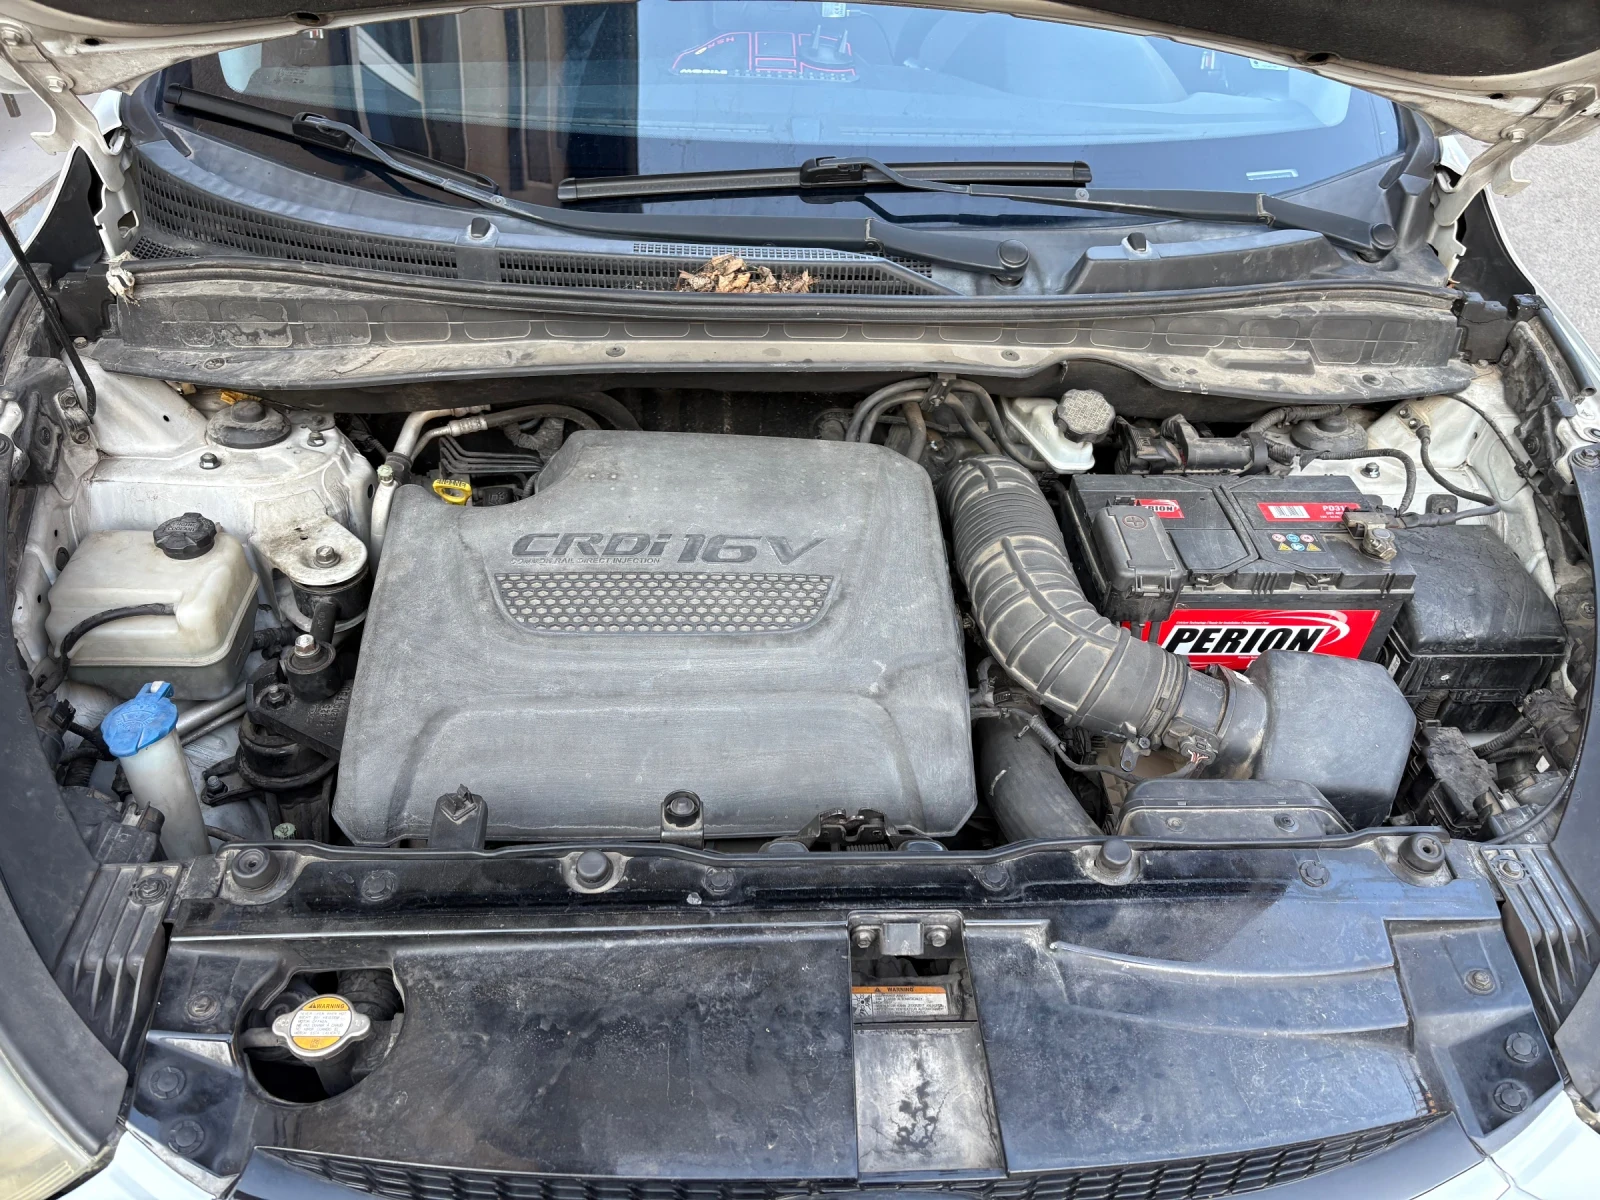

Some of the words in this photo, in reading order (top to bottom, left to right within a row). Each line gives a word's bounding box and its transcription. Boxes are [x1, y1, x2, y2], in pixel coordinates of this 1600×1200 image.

[436, 478, 467, 488] ENGINE
[511, 532, 672, 557] CRDi
[677, 534, 828, 566] 16V
[510, 557, 553, 565] COMMON
[1163, 627, 1326, 654] PERION
